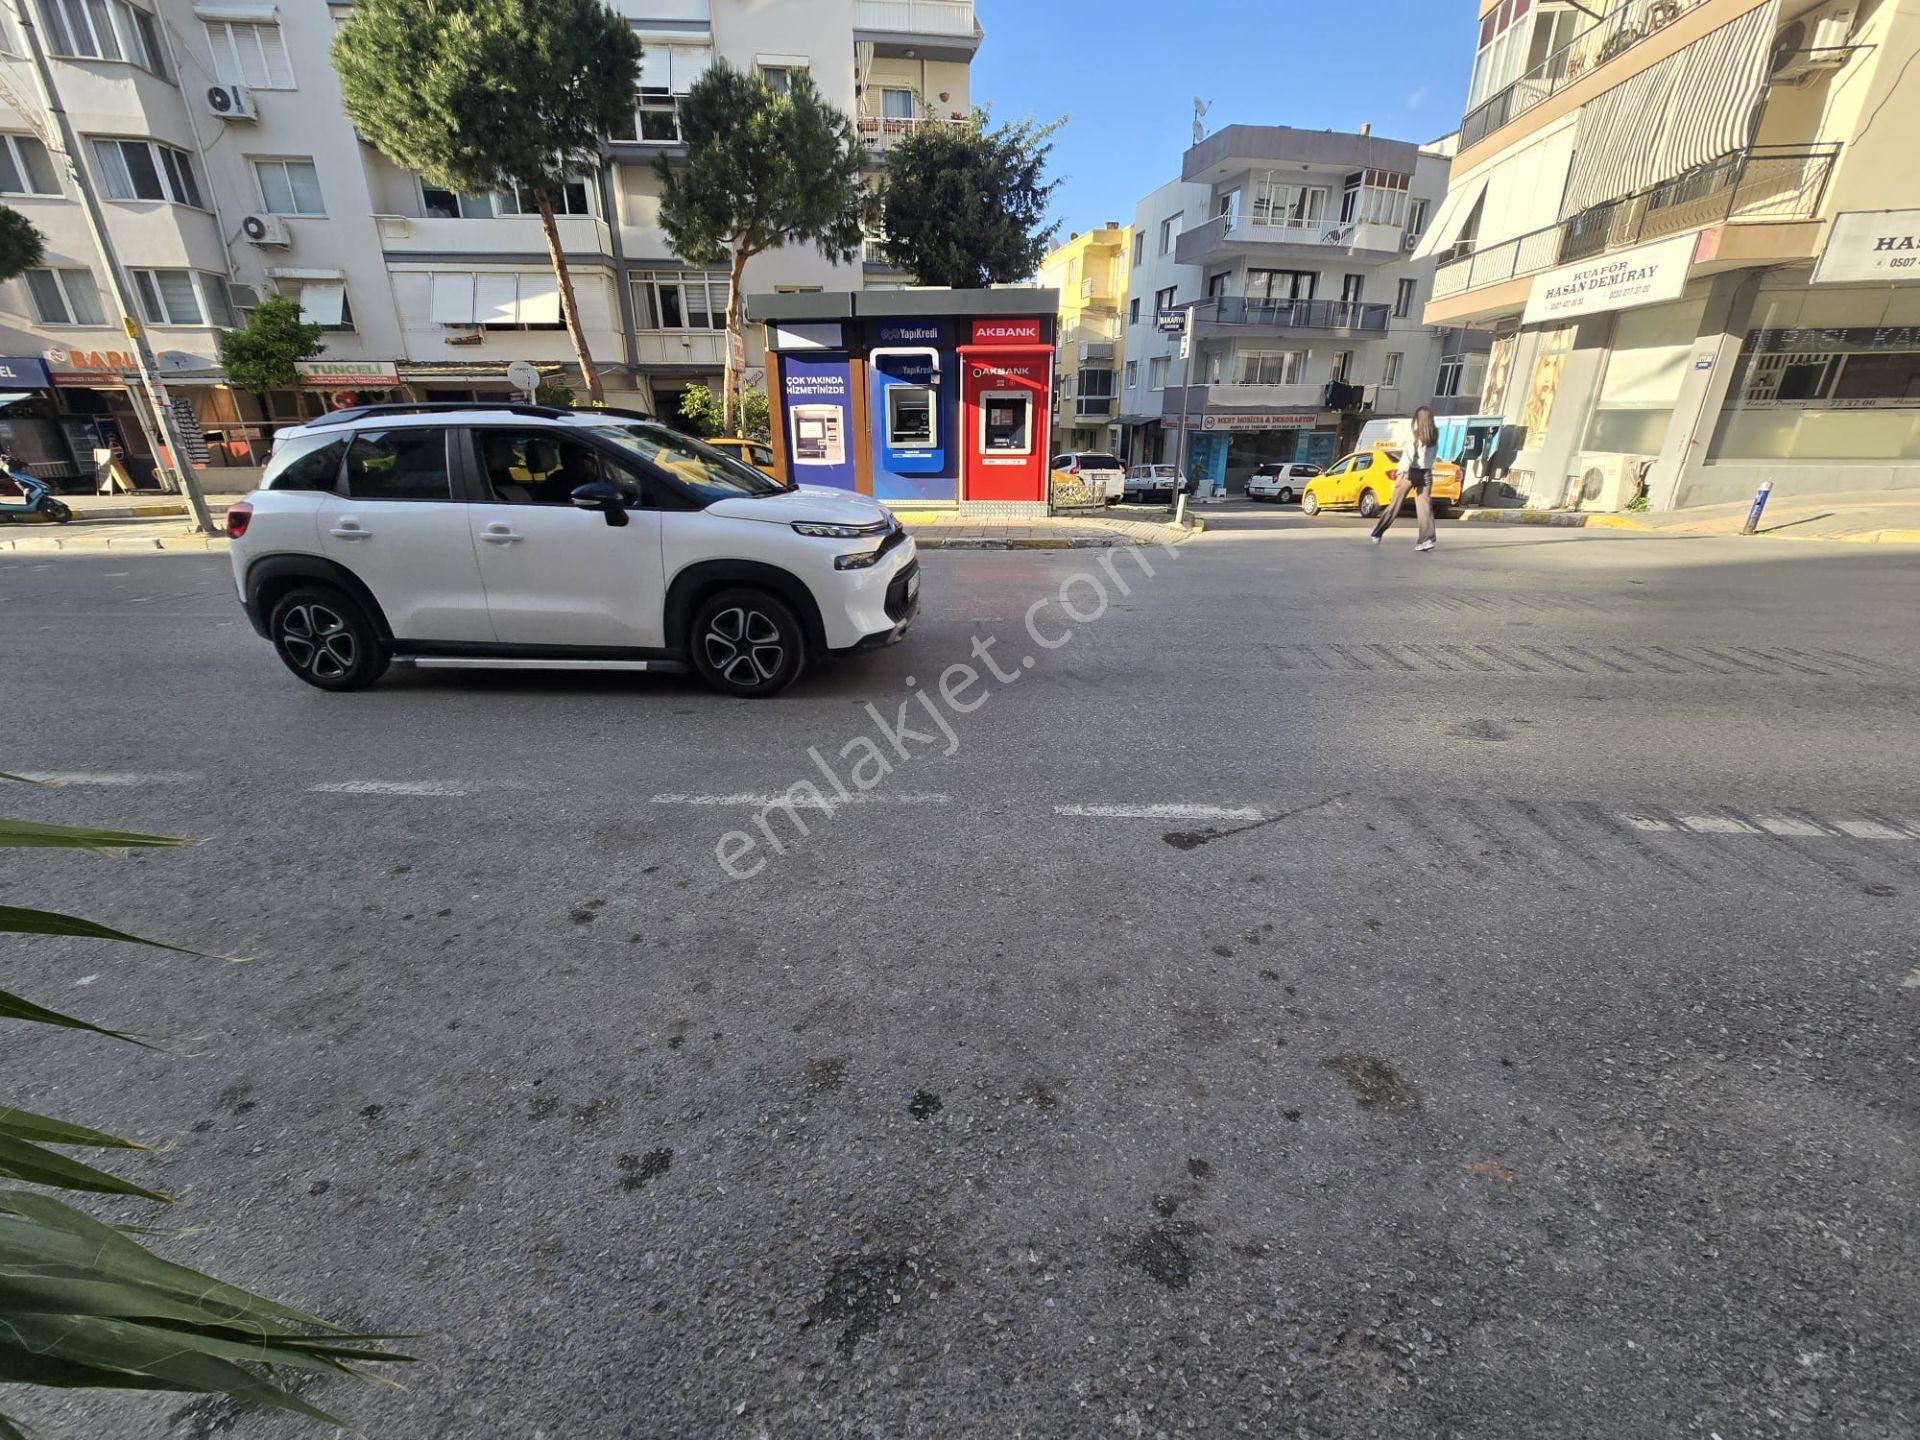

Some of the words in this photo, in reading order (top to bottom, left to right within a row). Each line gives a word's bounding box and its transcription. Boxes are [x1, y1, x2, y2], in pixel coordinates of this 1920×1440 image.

[1545, 281, 1589, 300] HASAN
[1588, 264, 1659, 290] DEMİRAY
[976, 328, 1036, 337] AKBANK
[982, 367, 1030, 375] AKBANK
[786, 377, 805, 386] ÇOK
[806, 376, 844, 385] YAKINDA
[786, 385, 845, 395] HİZMETİNİZDE
